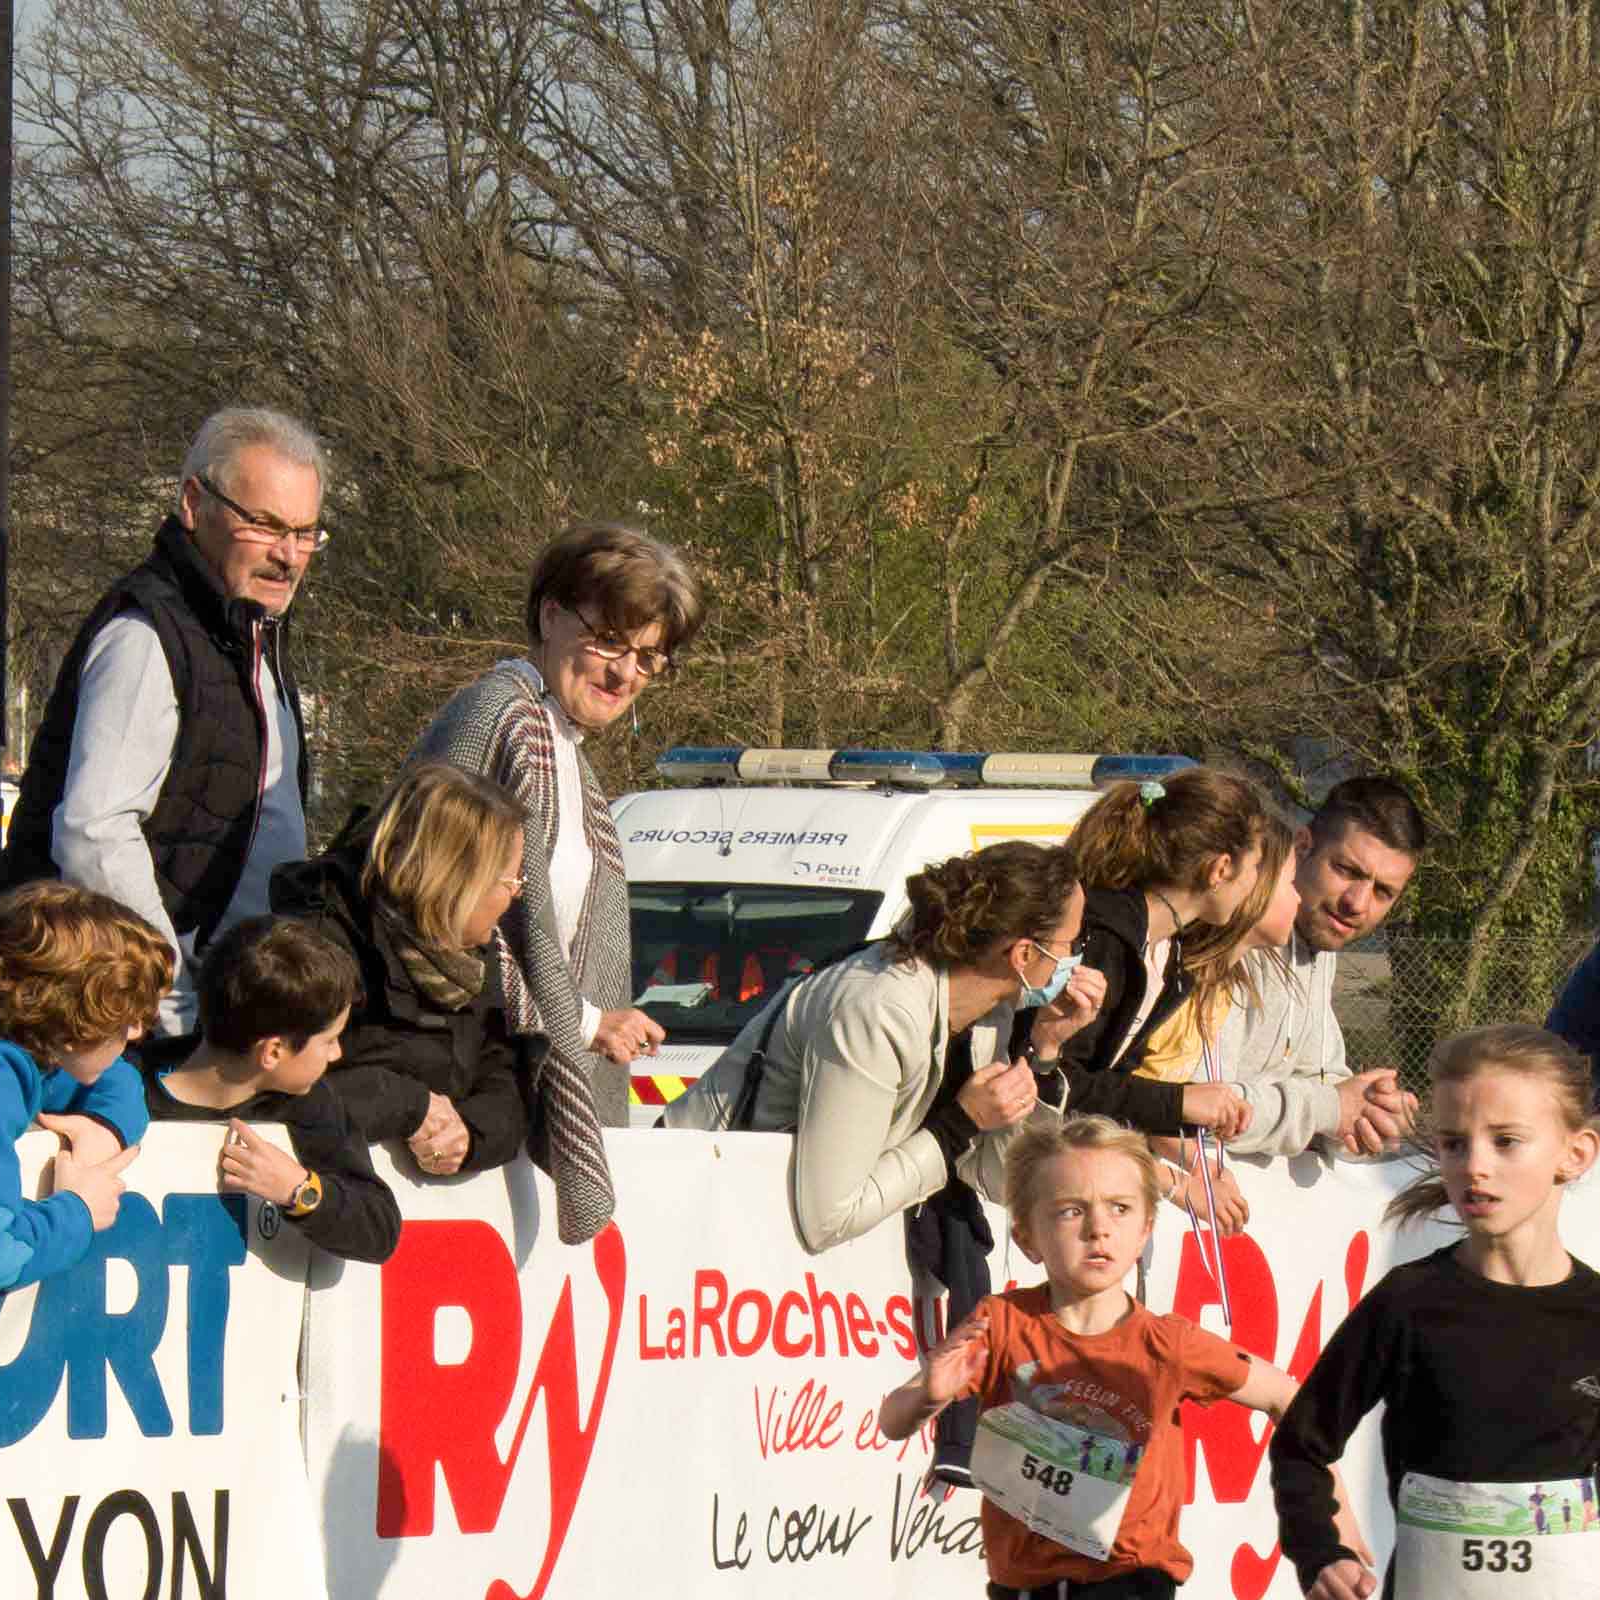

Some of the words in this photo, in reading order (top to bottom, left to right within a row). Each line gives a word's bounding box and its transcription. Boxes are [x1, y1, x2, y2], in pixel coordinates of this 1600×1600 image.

[753, 1378, 844, 1460] Ville
[1020, 1453, 1074, 1496] 548
[712, 1493, 753, 1570] Le
[1461, 1539, 1532, 1573] 533
